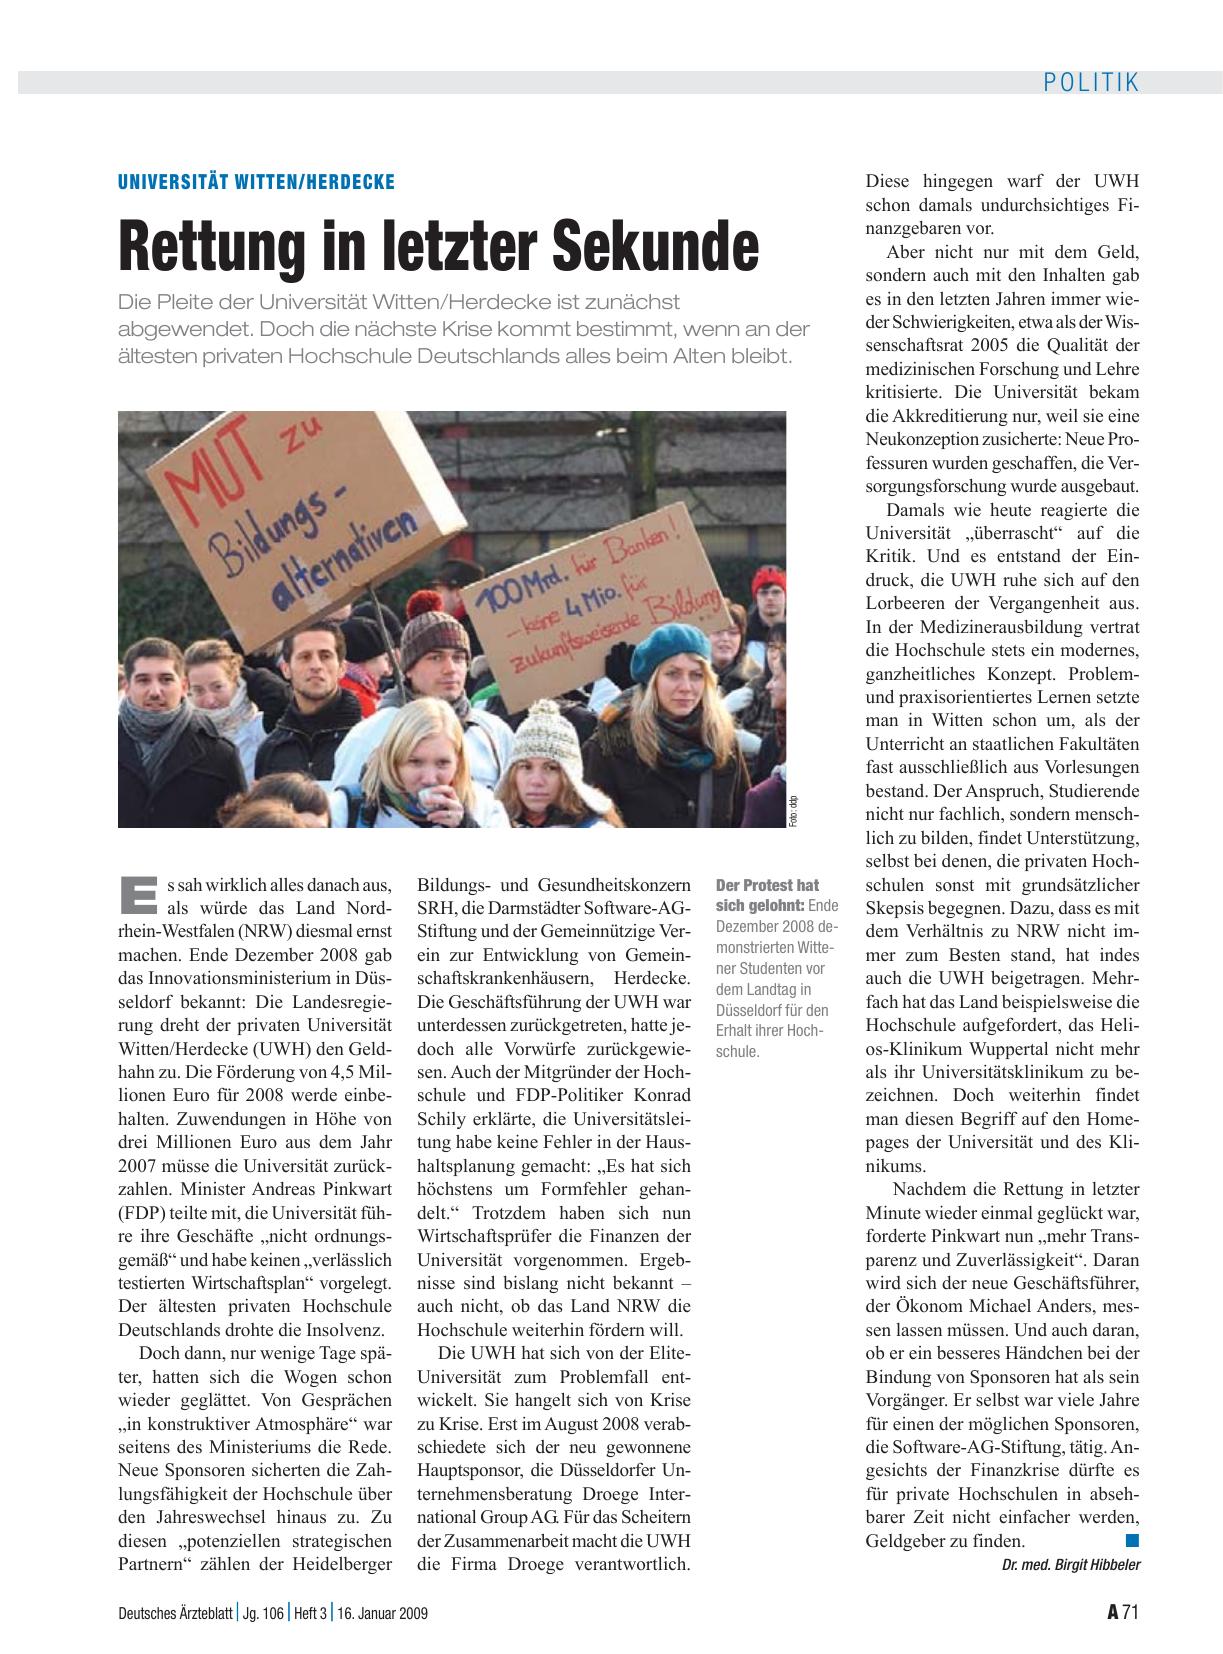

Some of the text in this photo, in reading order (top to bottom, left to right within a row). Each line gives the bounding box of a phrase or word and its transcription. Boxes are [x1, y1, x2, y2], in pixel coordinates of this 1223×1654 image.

[1044, 71, 1139, 92] POLITIK
[119, 170, 394, 189] UNIVERSITÄT WITTEN/HERDECKE
[866, 174, 1139, 191] Diese hingegen warf der UWH
[120, 218, 759, 283] Rettung in letzter Sekunde
[120, 294, 680, 309] Die Pleite der Universität Witten/Herdecke ist zunächst
[119, 321, 810, 340] abgewendet. Doch die nächste Krise kommt bestimmt, wenn an der
[866, 338, 1140, 355] senschaftsrat 2005 die Qualität der
[119, 348, 791, 367] ältesten privaten Hochschule Deutschlands alles beim Alten bleibt.
[164, 413, 323, 529] MUT zu
[271, 511, 419, 612] alternativen
[565, 598, 583, 617] 4
[581, 587, 623, 613] Mio.
[620, 573, 649, 600] für
[509, 586, 722, 675] zukunftsweisende Bildung
[866, 760, 1139, 777] fast ausschließlich aus Vorlesungen
[418, 878, 690, 895] Bildungs- und Gesundheitskonzern
[716, 879, 819, 892] Der Protest hat
[716, 899, 838, 914] sich gelohnt: Ende
[119, 924, 392, 941] rhein-Westfalen (NRW) diesmal ernst
[716, 920, 839, 933] Dezember 2008 de-
[716, 941, 835, 954] monstrierten Witte-
[716, 962, 826, 975] ner Studenten vor
[716, 983, 811, 999] dem Landtag in
[119, 995, 392, 1012] seldorf bekannt: Die Landesregie-
[716, 1004, 829, 1017] Düsseldorf für den
[716, 1024, 824, 1037] Erhalt ihrer Hoch-
[866, 1018, 1139, 1035] Hochschule aufgefordert, das Heli-
[716, 1045, 760, 1058] schule.
[418, 1088, 691, 1101] schule und FDP-Politiker Konrad
[866, 1159, 925, 1172] nikums.
[893, 1182, 1140, 1199] Nachdem die Rettung in letzter
[418, 1229, 691, 1246] Wirtschaftsprüfer die Finanzen der
[119, 1299, 391, 1316] Der ältesten privaten Hochschule
[119, 1393, 392, 1410] wieder geglättet. Von Gesprächen
[119, 1510, 392, 1523] den Jahreswechsel hinaus zu. Zu
[866, 1510, 1139, 1526] barer Zeit nicht einfacher werden,
[418, 1557, 690, 1574] die Firma Droege verantwortlich.
[1002, 1559, 1142, 1573] Dr. med. Birgit Hibbeler
[118, 1604, 428, 1622] Deutsches Ärzteblatt Jg. 106 Heft 3 16. Januar 2009
[1107, 1604, 1138, 1620] A 71
